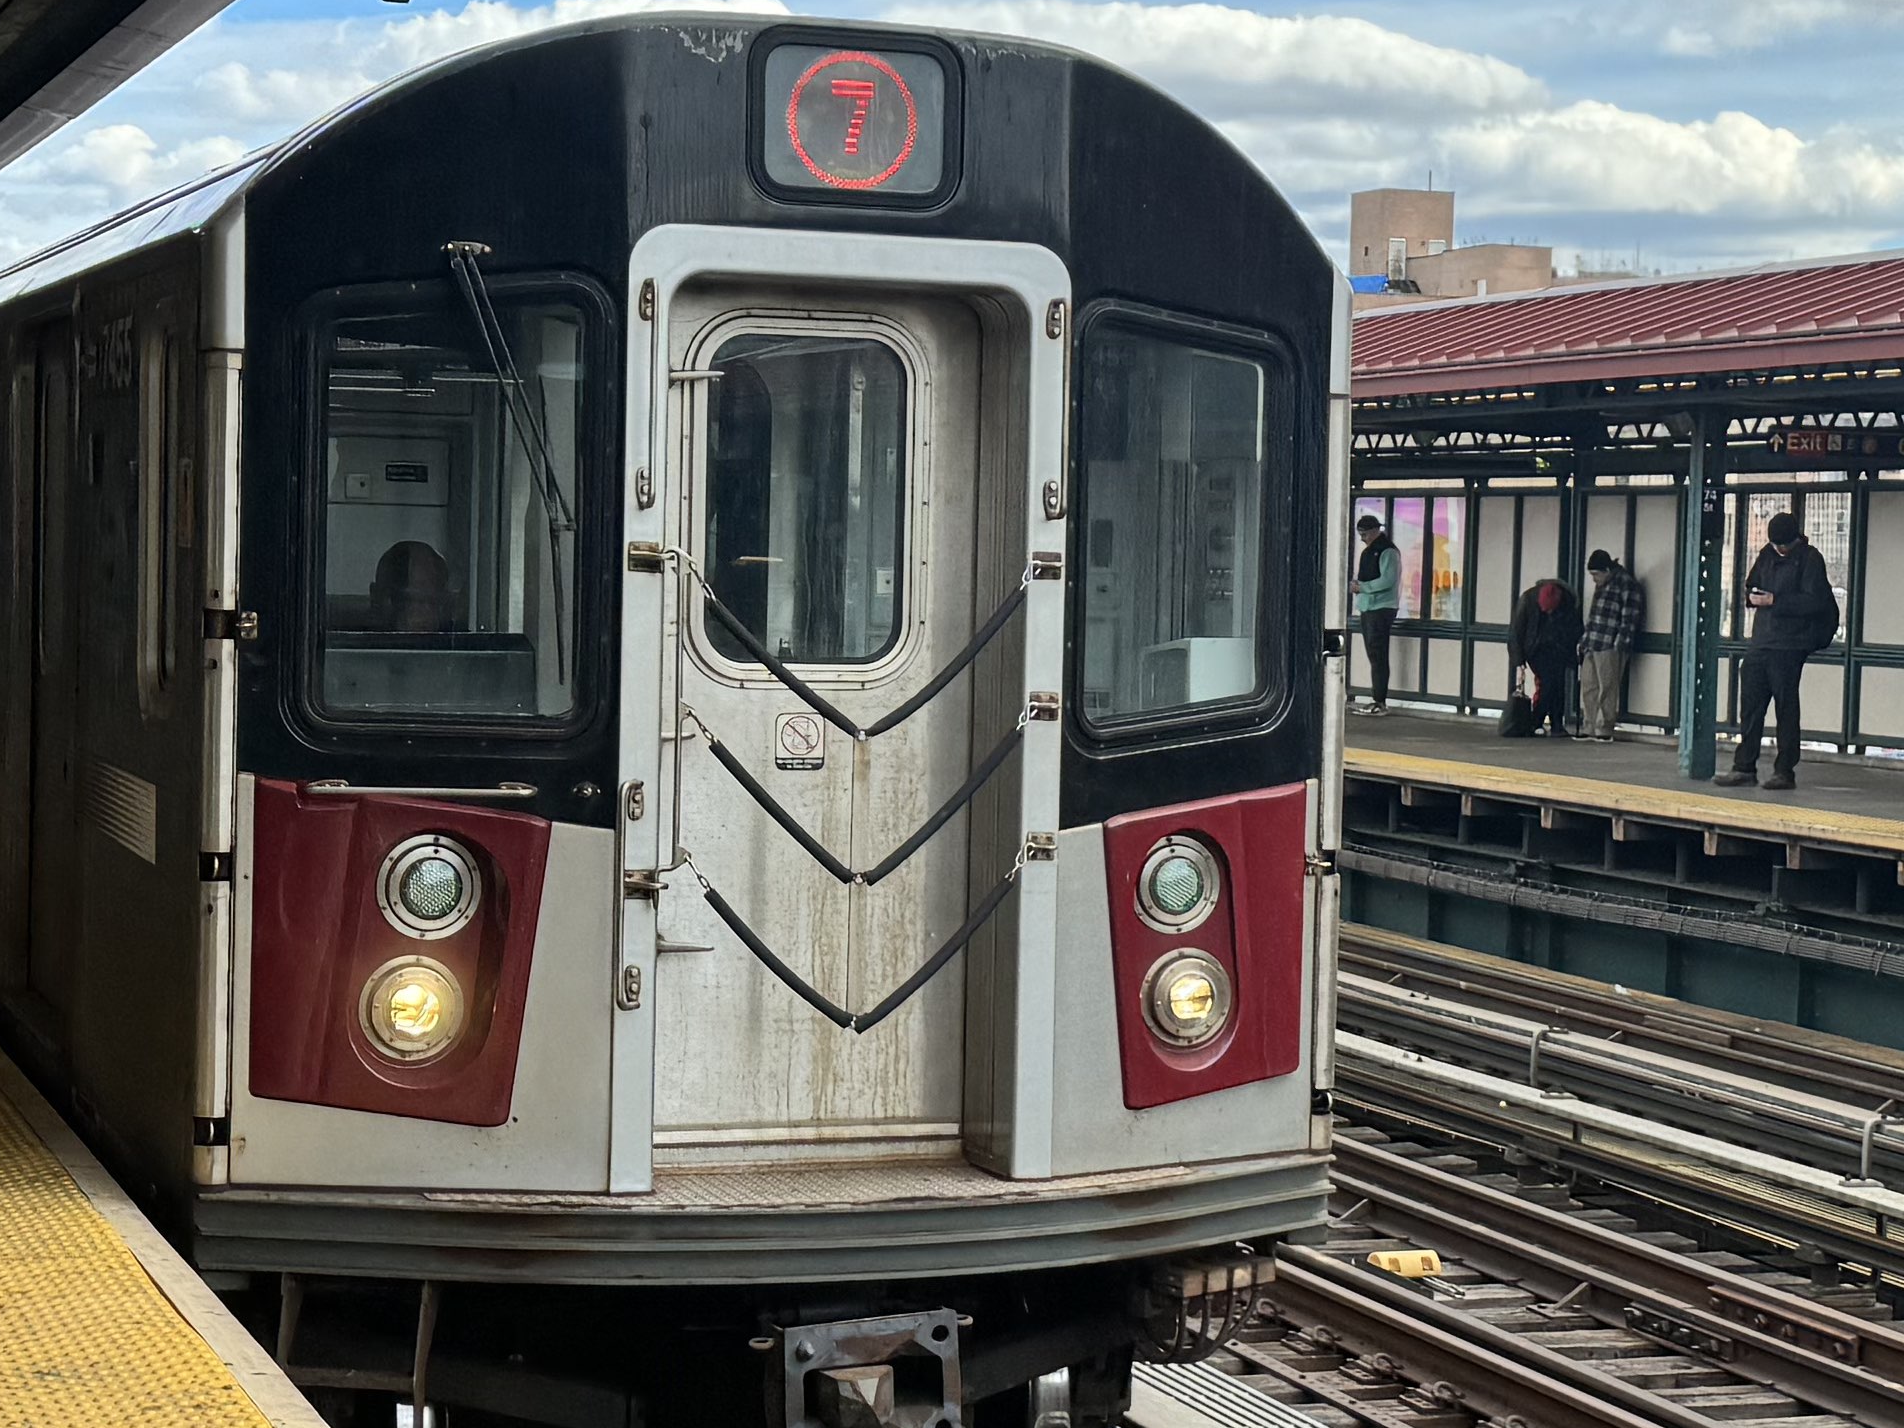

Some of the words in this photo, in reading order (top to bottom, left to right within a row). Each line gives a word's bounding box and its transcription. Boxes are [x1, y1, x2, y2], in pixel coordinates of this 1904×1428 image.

[831, 79, 875, 156] 7
[1787, 433, 1821, 451] Exit
[1704, 489, 1717, 501] 74
[1703, 502, 1714, 512] St
